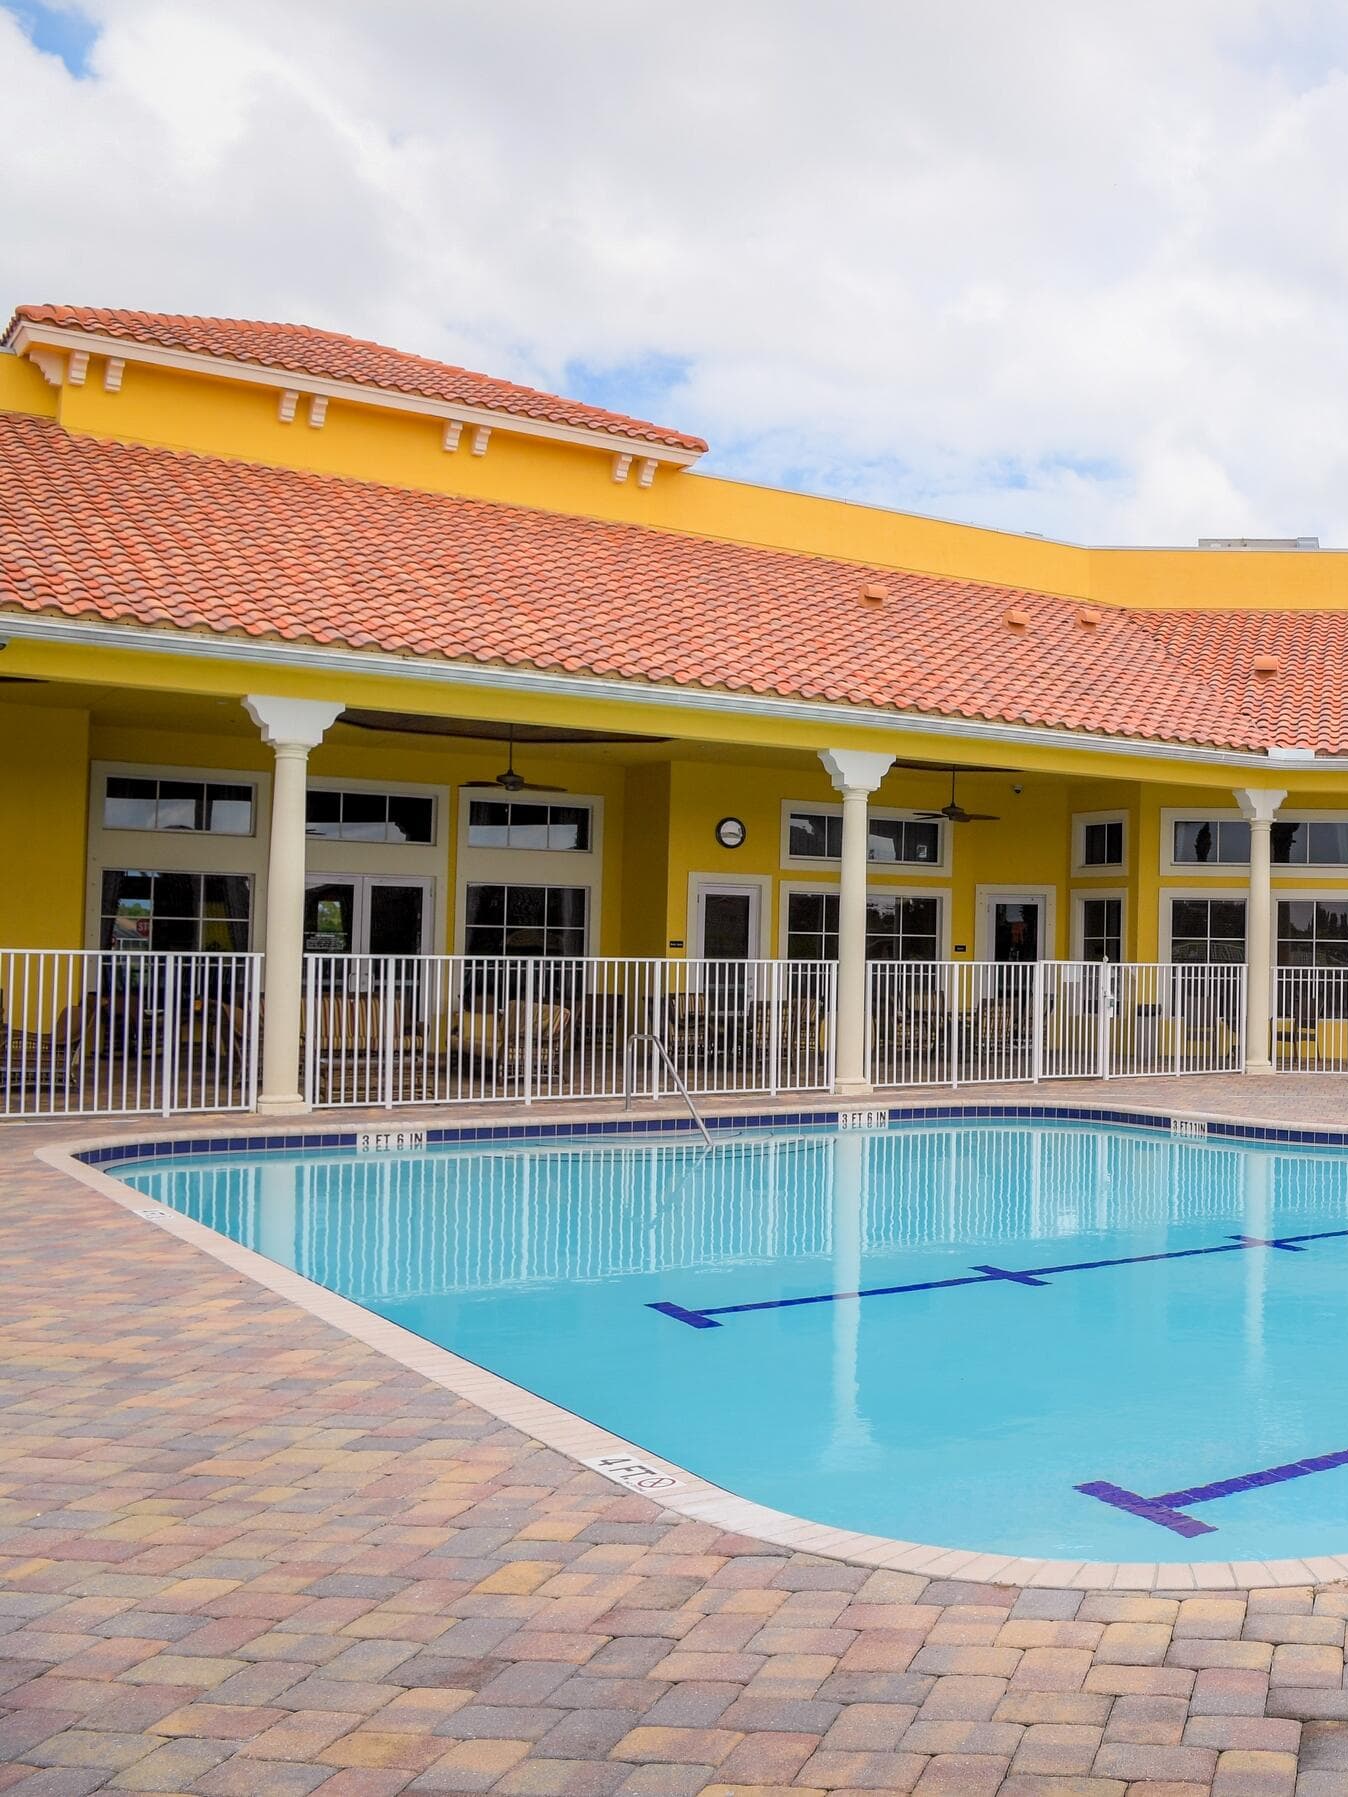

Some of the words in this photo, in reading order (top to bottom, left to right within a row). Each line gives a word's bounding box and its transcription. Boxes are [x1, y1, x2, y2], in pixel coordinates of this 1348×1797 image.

[842, 1113, 848, 1124] 3
[852, 1112, 863, 1123] FT
[867, 1112, 873, 1122] 6
[876, 1111, 886, 1121] IN
[362, 1134, 370, 1145] 3
[376, 1134, 391, 1145] FT
[397, 1133, 404, 1144] 6
[410, 1132, 423, 1143] IN
[598, 1458, 632, 1466] 4
